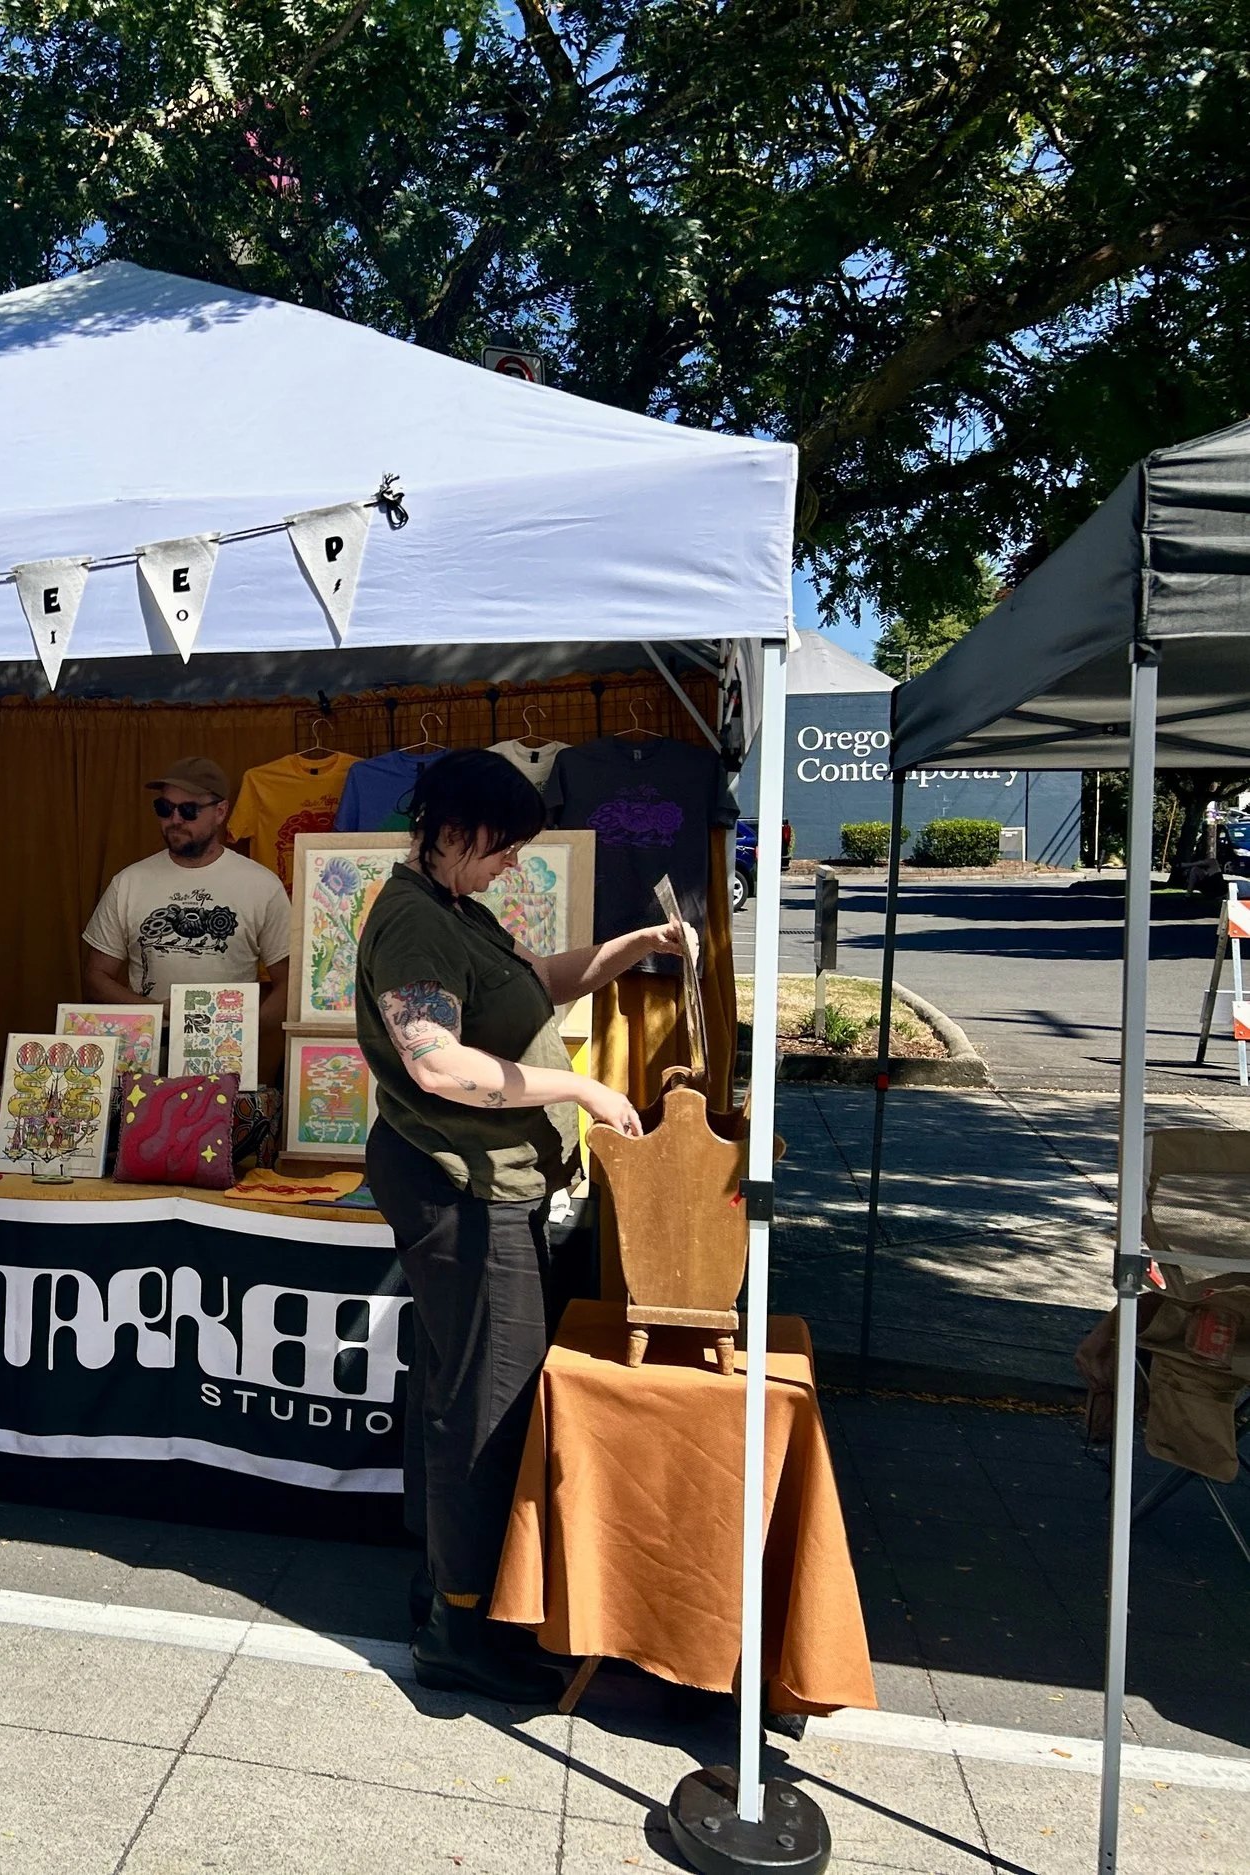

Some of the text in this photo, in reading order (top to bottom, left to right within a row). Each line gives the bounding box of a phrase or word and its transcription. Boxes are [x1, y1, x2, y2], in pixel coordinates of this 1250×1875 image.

[797, 726, 890, 757] Orego
[797, 757, 1018, 787] Conteporary
[200, 1383, 394, 1434] STUDIO
